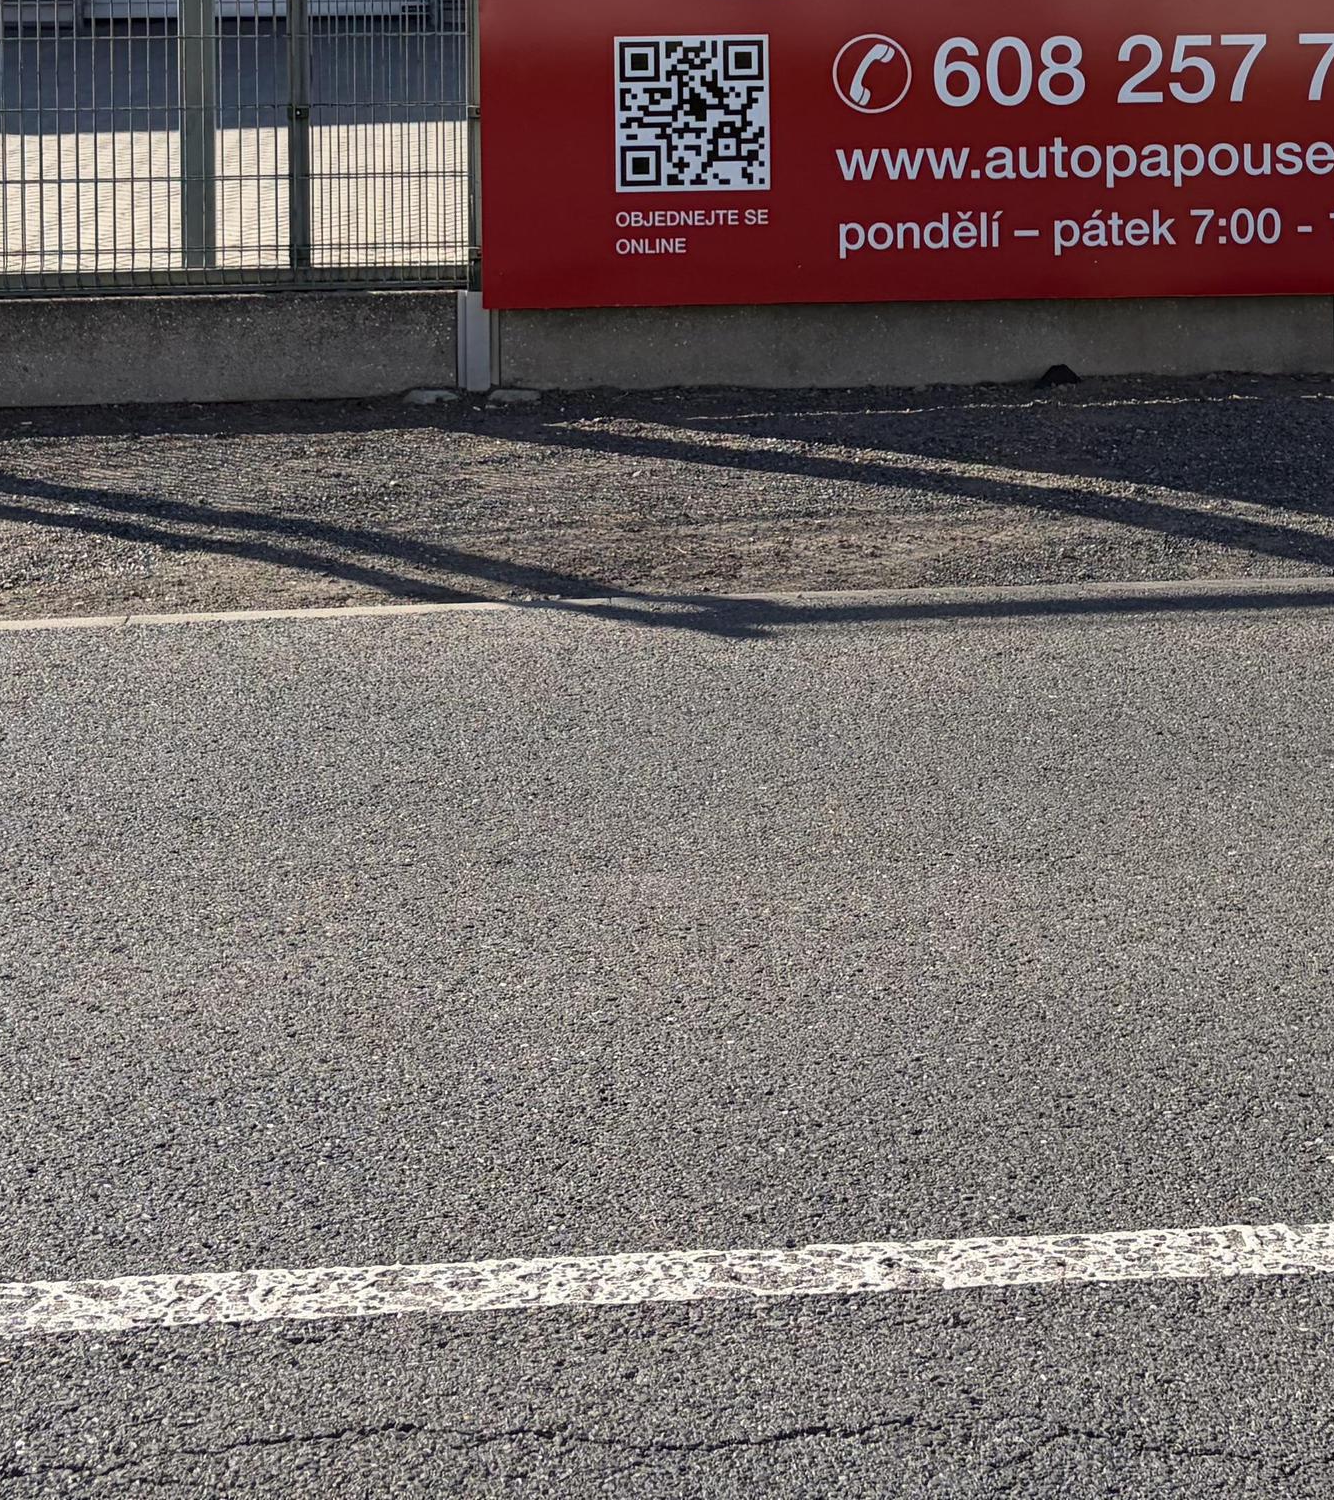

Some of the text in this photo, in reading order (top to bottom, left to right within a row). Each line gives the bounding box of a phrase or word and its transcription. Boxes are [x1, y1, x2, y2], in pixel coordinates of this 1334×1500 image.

[933, 35, 1086, 107] 608
[1117, 33, 1267, 104] 257
[615, 209, 769, 228] OBJEDNEJTE SE
[839, 210, 1004, 259] pondělí
[1054, 209, 1177, 256] pátek
[1190, 207, 1281, 245] 7:00
[615, 237, 687, 255] ONLINE
